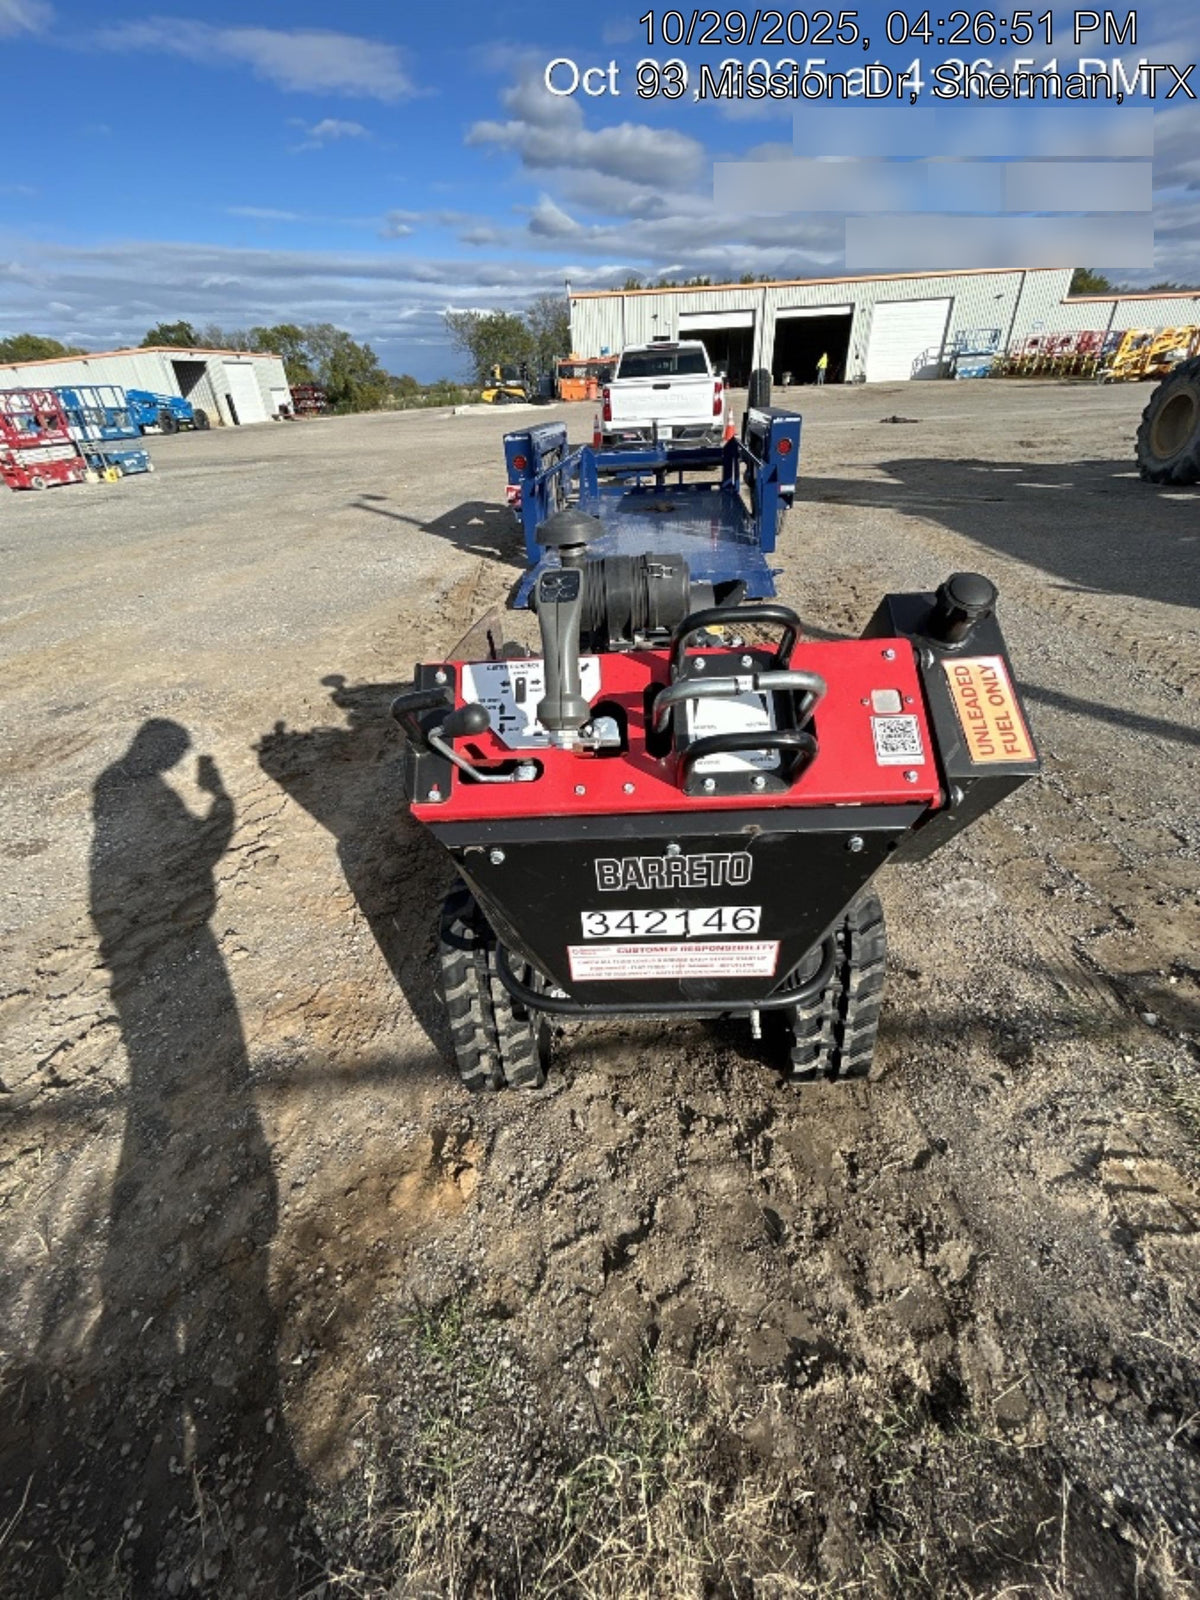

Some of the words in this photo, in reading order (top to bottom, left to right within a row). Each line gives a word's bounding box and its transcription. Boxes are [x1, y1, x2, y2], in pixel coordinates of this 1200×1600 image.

[977, 664, 1006, 707] ONLY
[954, 665, 995, 757] UNLEADED
[994, 711, 1022, 755] FUEL
[594, 851, 753, 892] BARRETO
[585, 907, 757, 937] 342146
